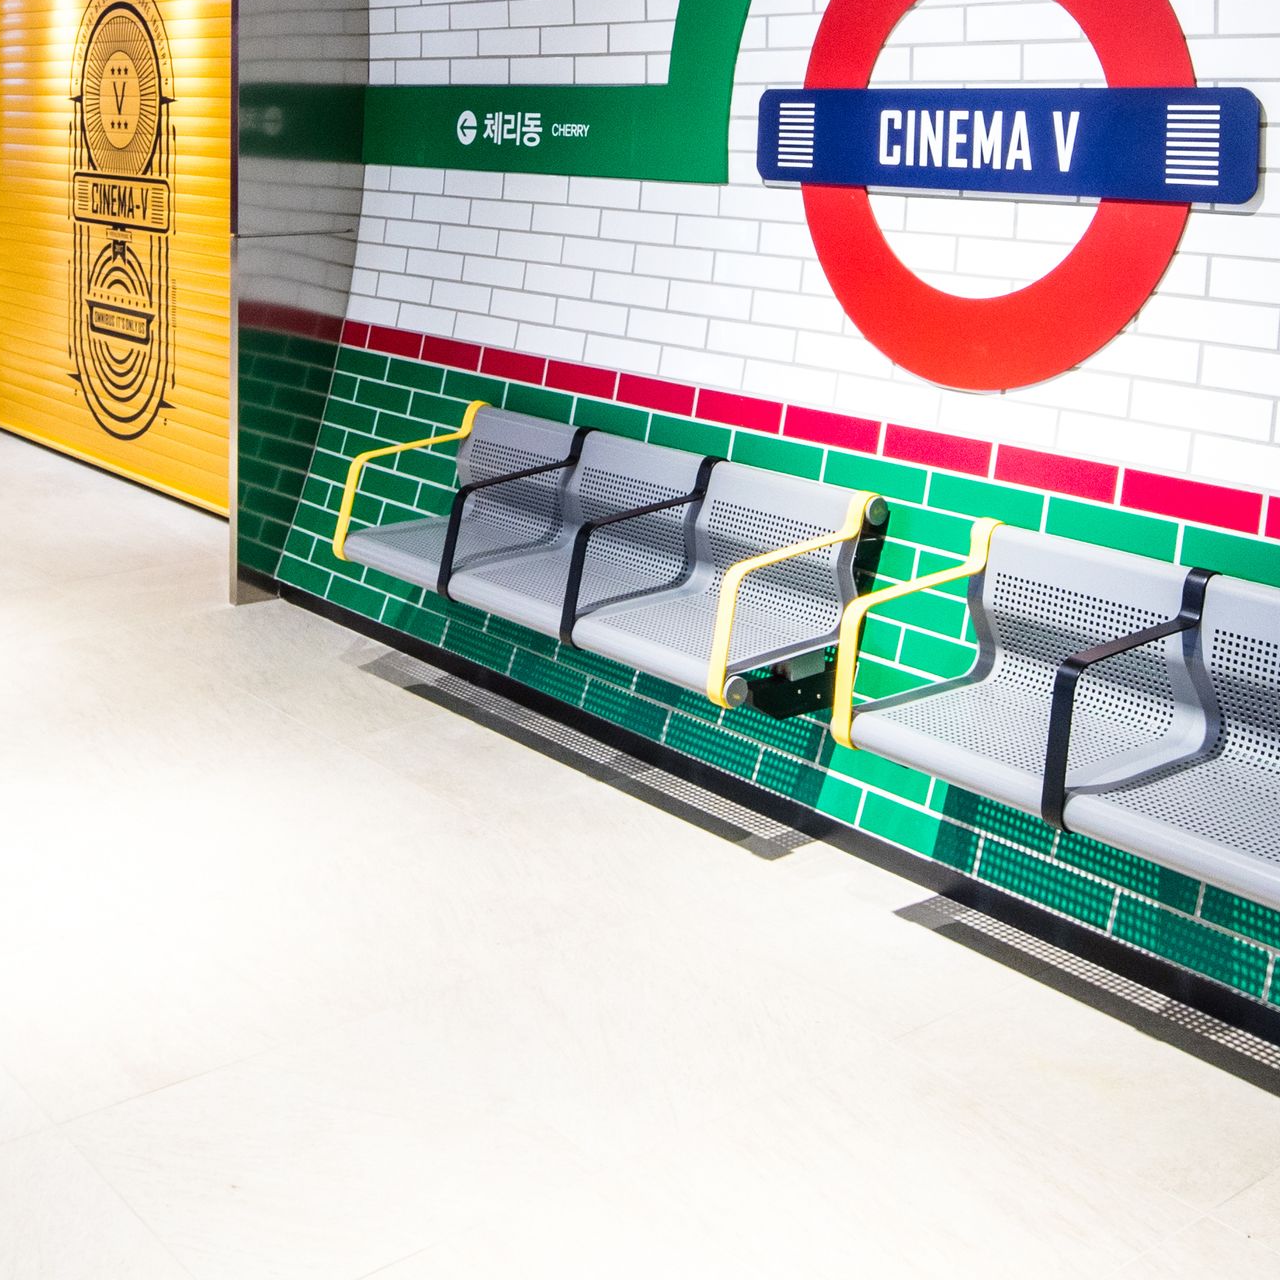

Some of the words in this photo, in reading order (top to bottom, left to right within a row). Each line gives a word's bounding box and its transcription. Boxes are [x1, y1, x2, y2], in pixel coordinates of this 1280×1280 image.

[113, 81, 126, 115] V
[483, 111, 543, 147] 체리동
[551, 123, 590, 137] CHERRY
[879, 109, 1032, 172] CINEMA
[1053, 110, 1080, 173] V
[91, 182, 149, 220] CINEMA-V
